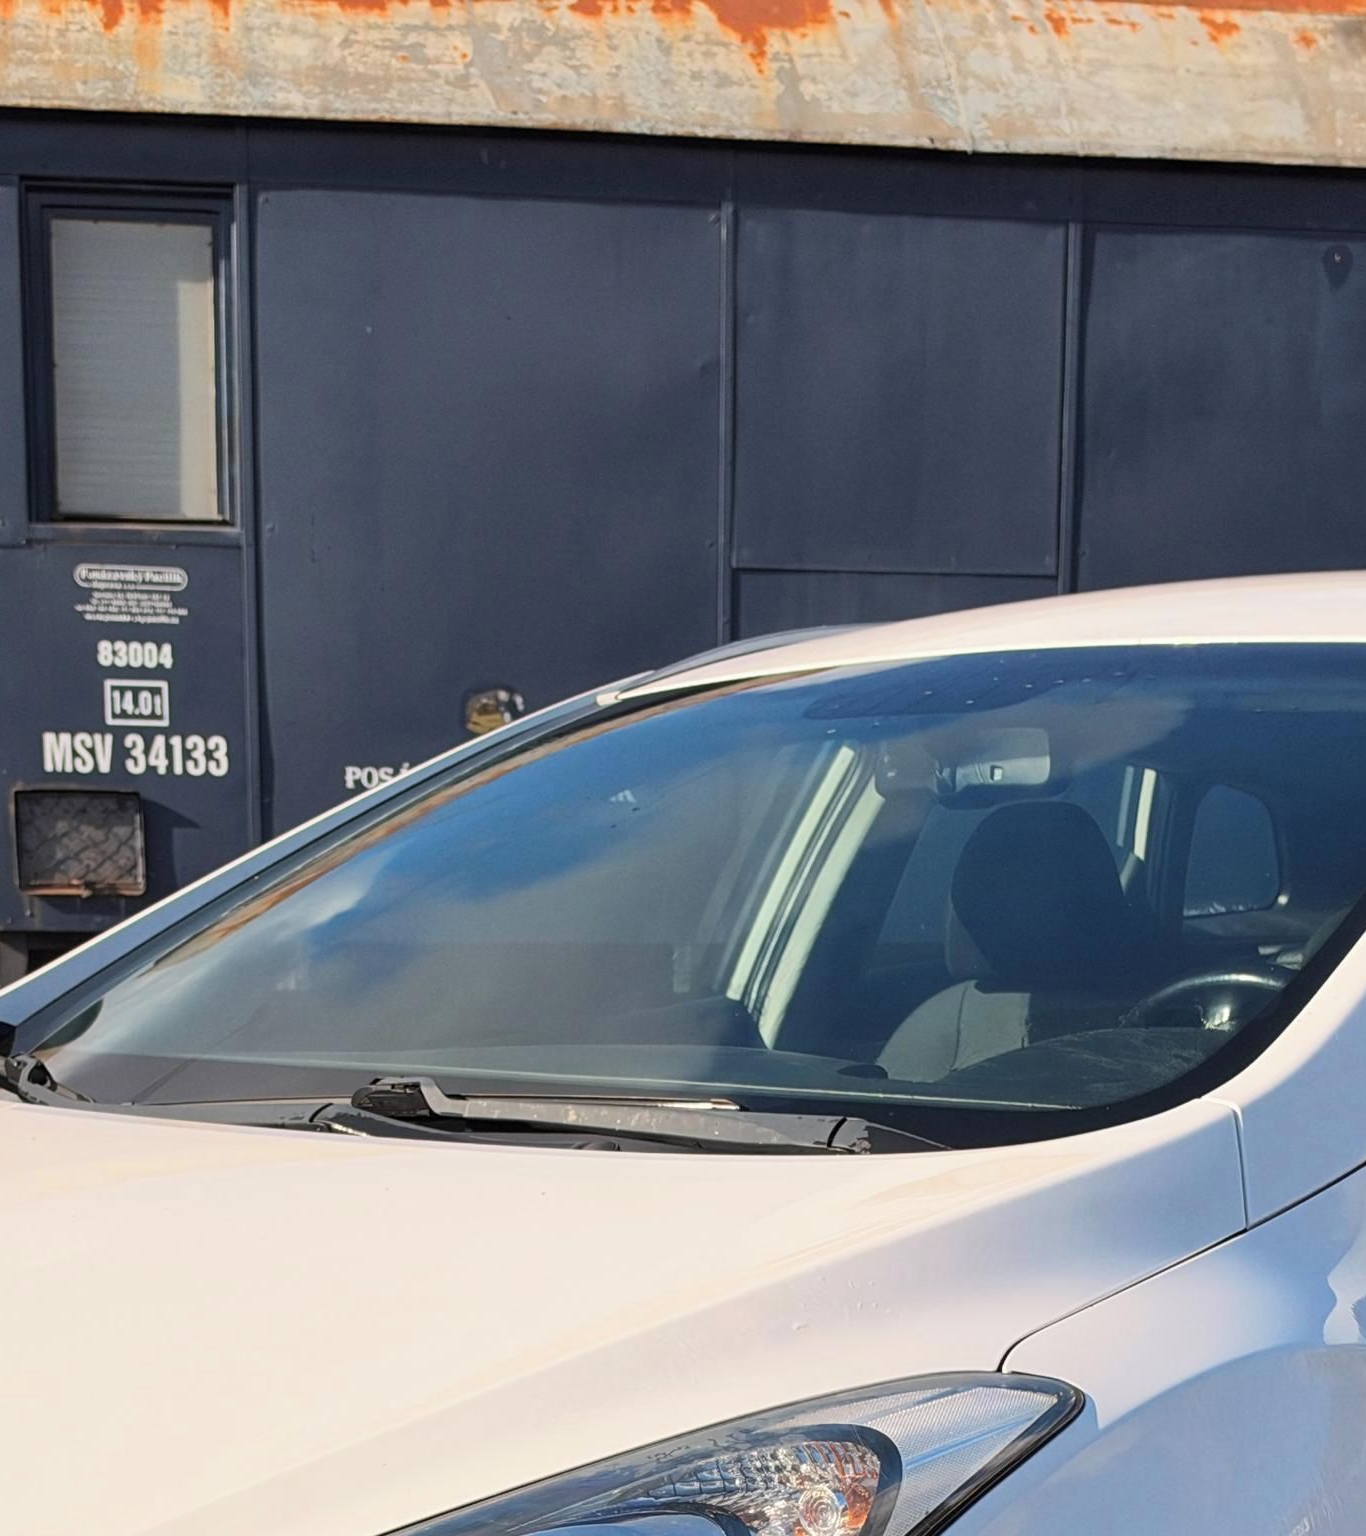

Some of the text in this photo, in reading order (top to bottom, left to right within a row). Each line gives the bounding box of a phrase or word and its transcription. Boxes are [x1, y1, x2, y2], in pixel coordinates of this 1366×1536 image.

[96, 639, 174, 669] 83004
[41, 731, 230, 777] MSV 34133
